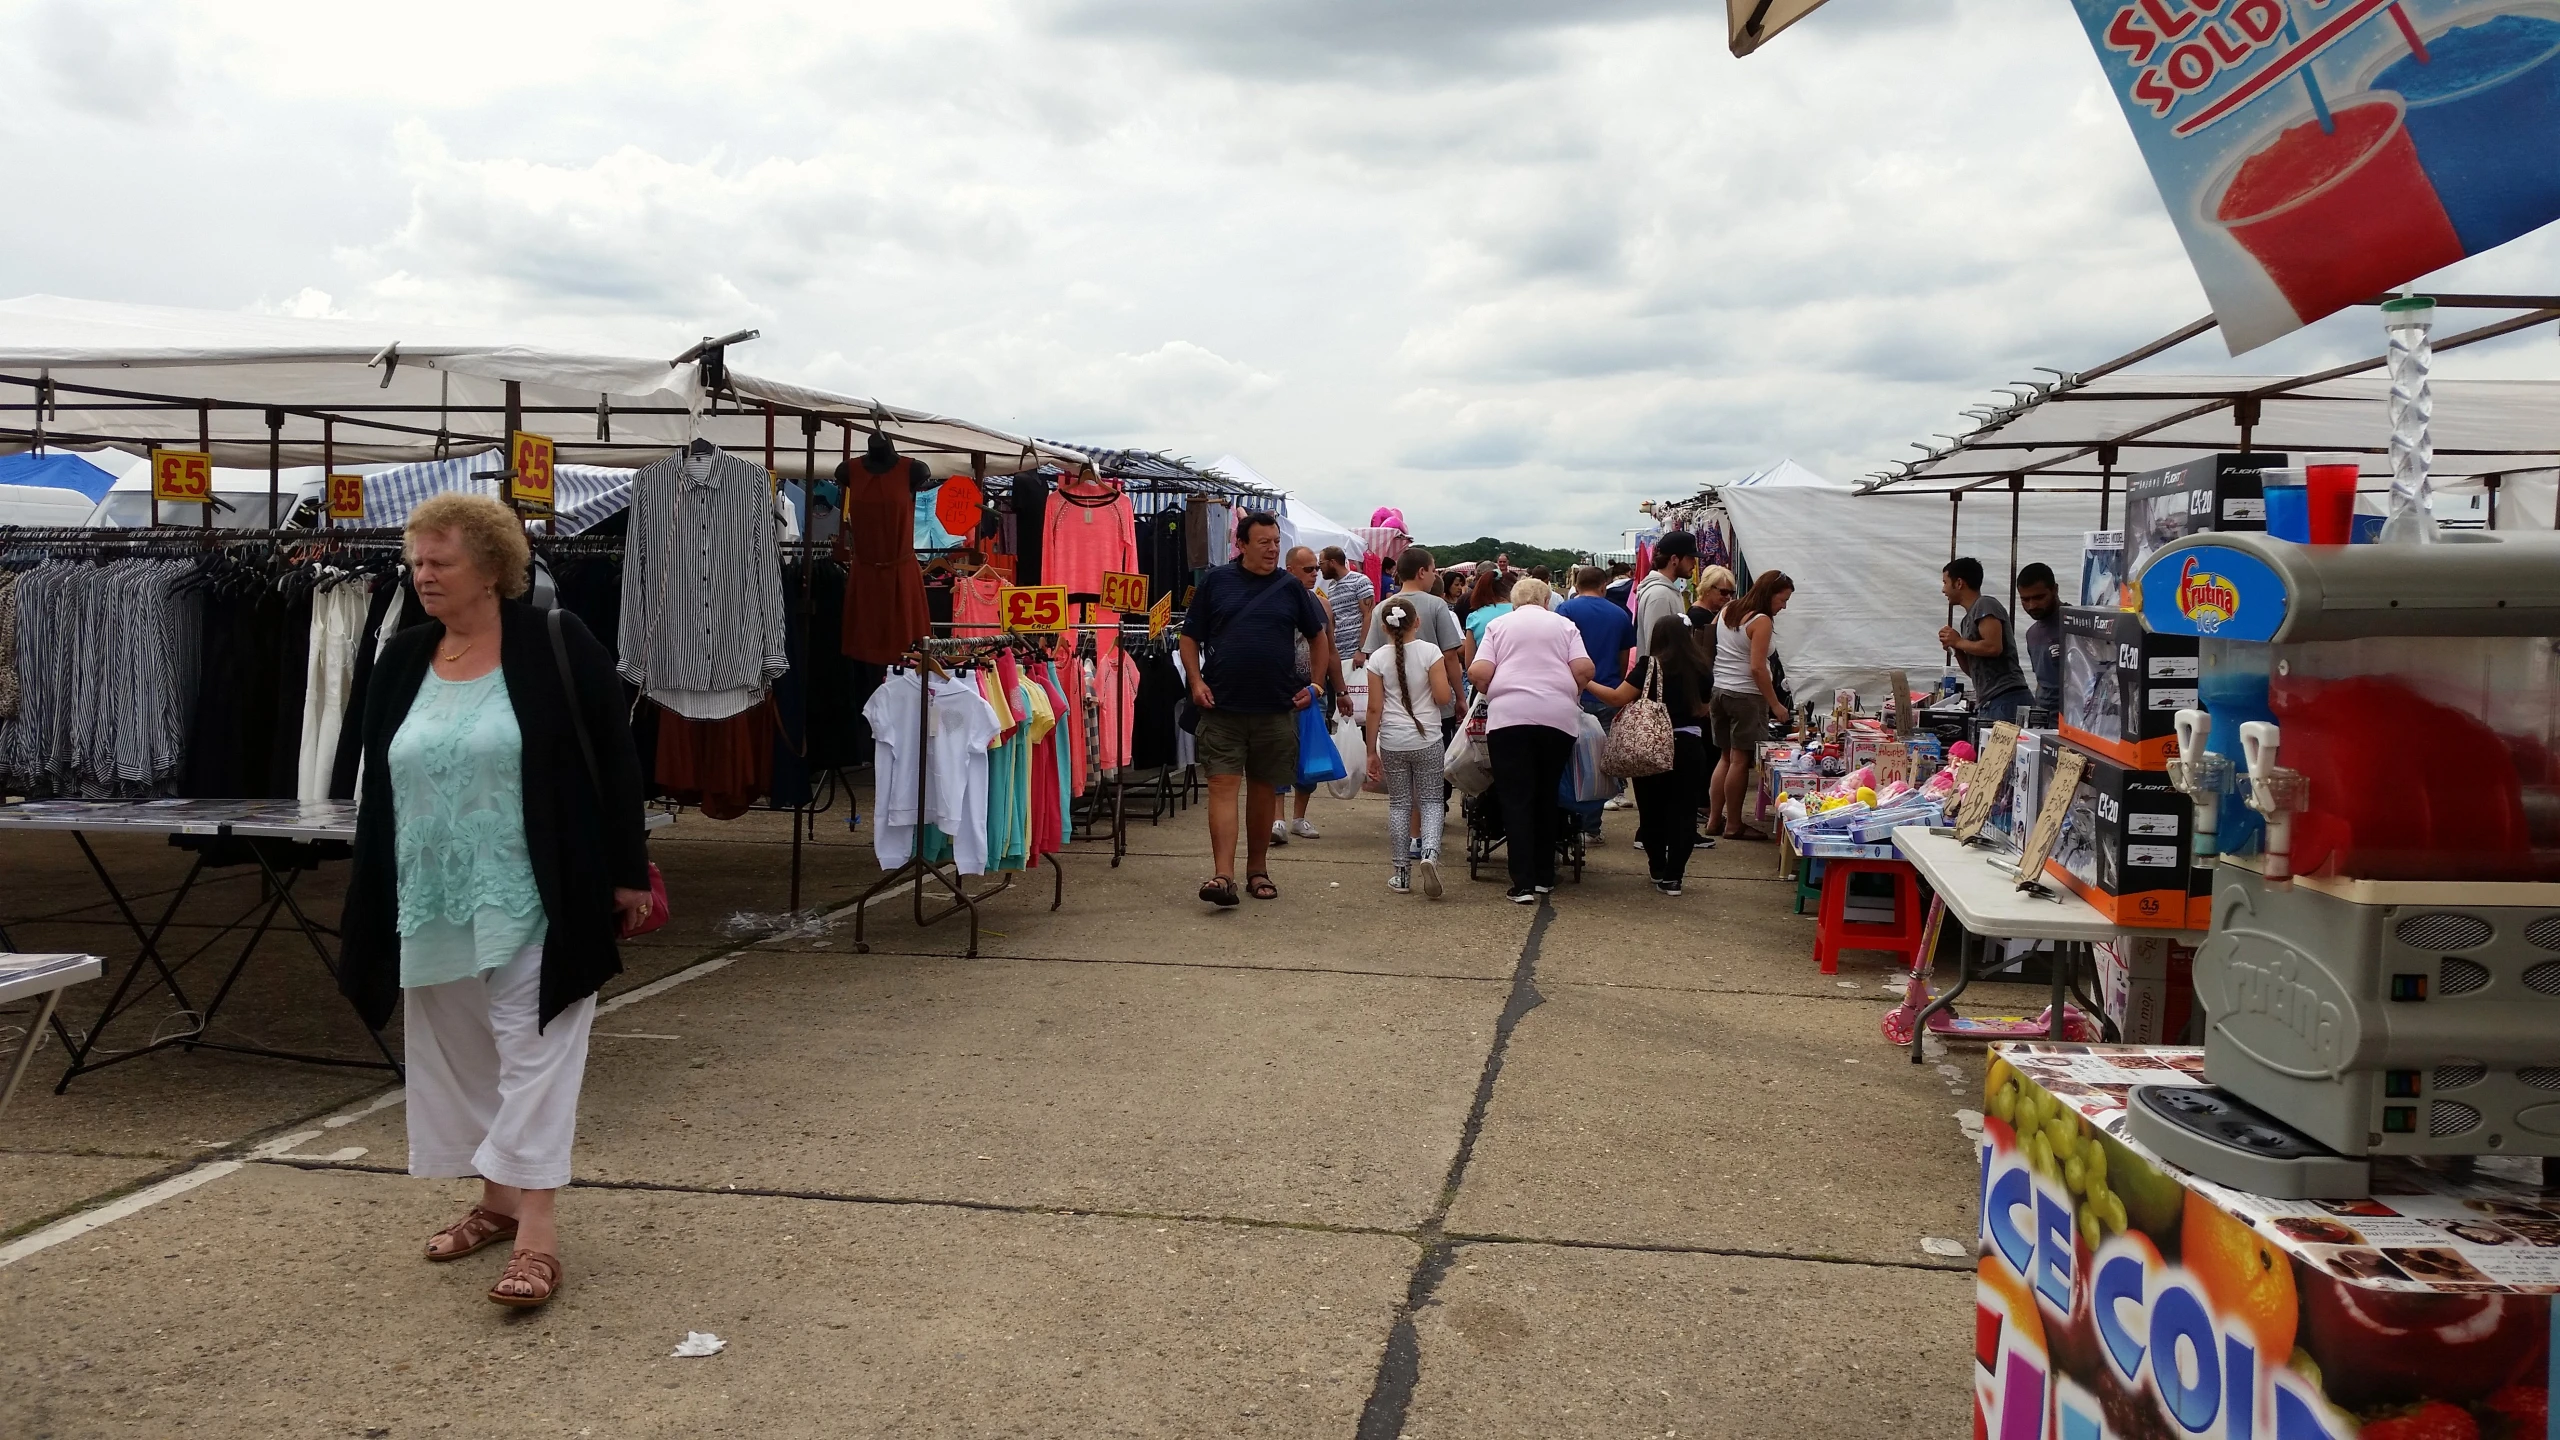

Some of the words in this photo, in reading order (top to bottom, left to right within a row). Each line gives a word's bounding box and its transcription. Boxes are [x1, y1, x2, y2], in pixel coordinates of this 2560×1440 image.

[2107, 0, 2224, 62] SL
[2136, 0, 2283, 113] SOLD
[161, 458, 206, 495] £5
[518, 439, 549, 490] £5
[333, 479, 361, 512] £5
[948, 486, 972, 499] SALE
[2190, 489, 2213, 516] CX-20
[945, 509, 967, 524] £15
[1105, 576, 1144, 608] £10
[1007, 591, 1061, 626] £5
[2119, 643, 2139, 670] CX-20
[2098, 792, 2119, 824] CX-20
[2141, 900, 2159, 912] 3.5
[2141, 991, 2154, 1020] mop
